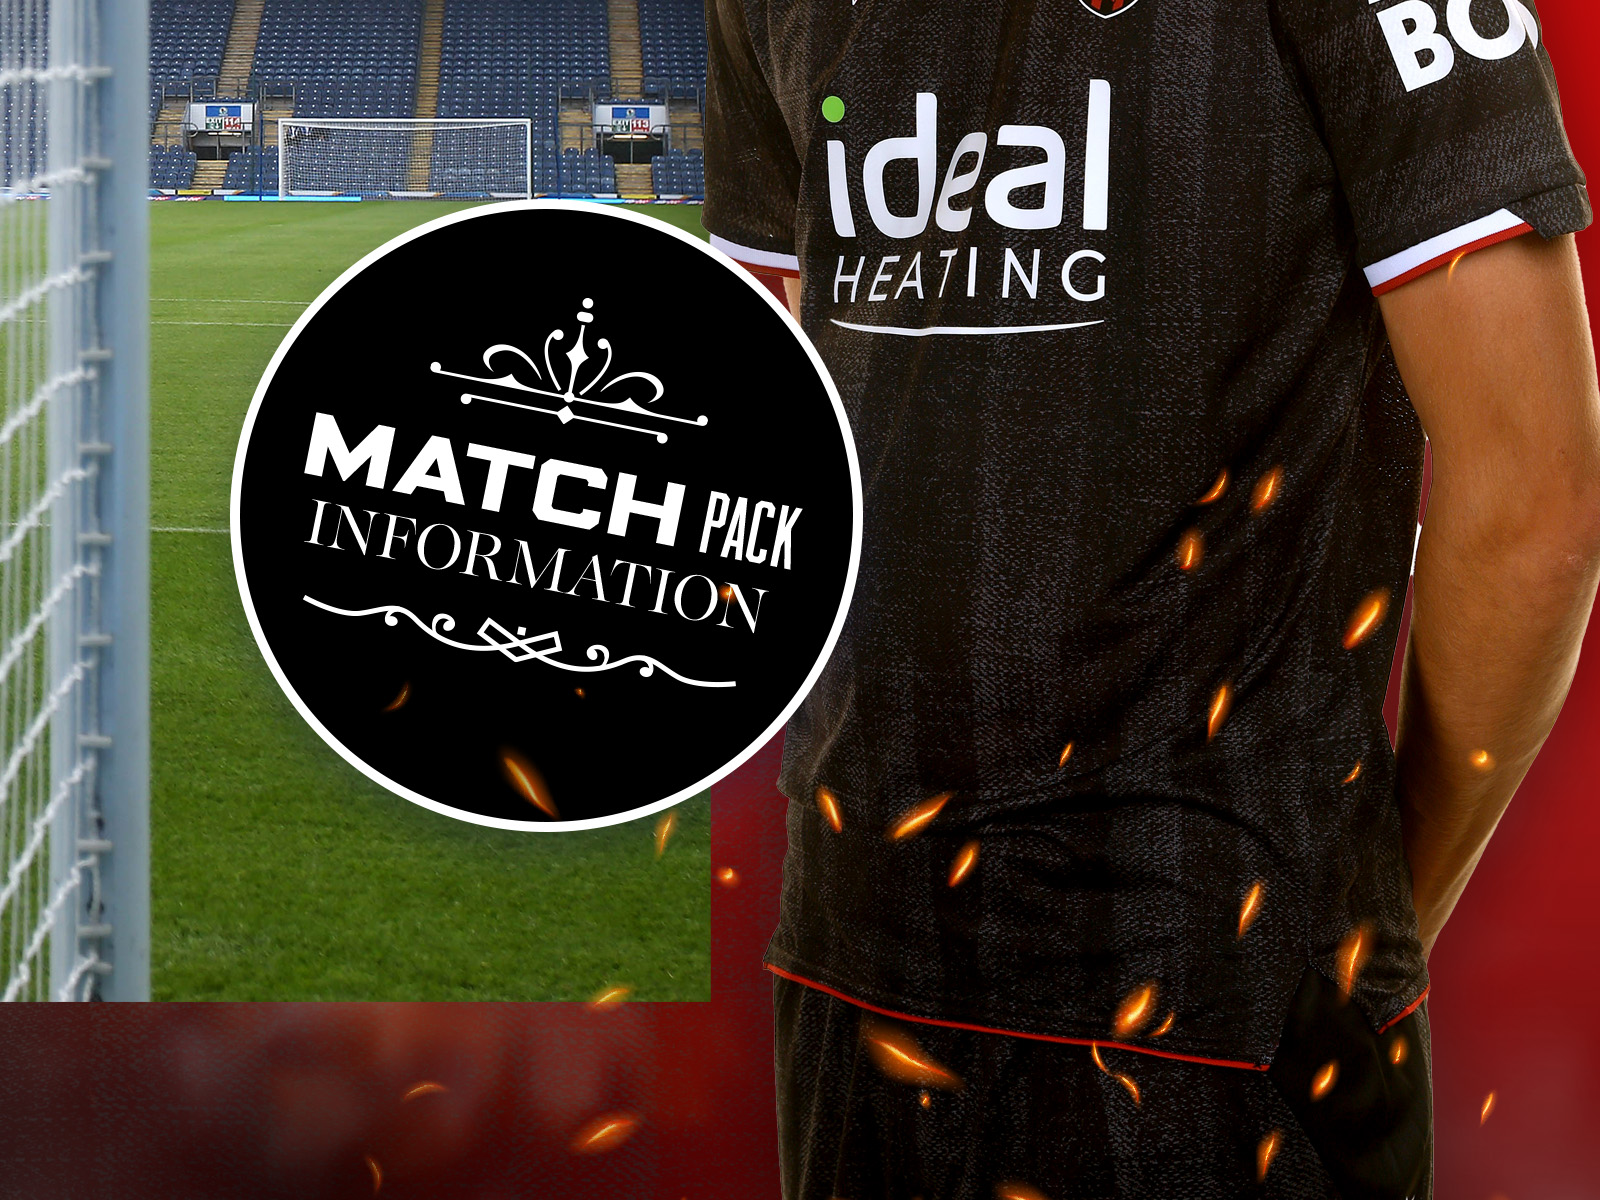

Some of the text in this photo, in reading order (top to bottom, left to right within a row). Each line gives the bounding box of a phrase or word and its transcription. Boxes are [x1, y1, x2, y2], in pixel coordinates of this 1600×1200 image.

[632, 120, 649, 128] 113
[822, 79, 1111, 238] ideal
[833, 247, 1106, 302] HEATING
